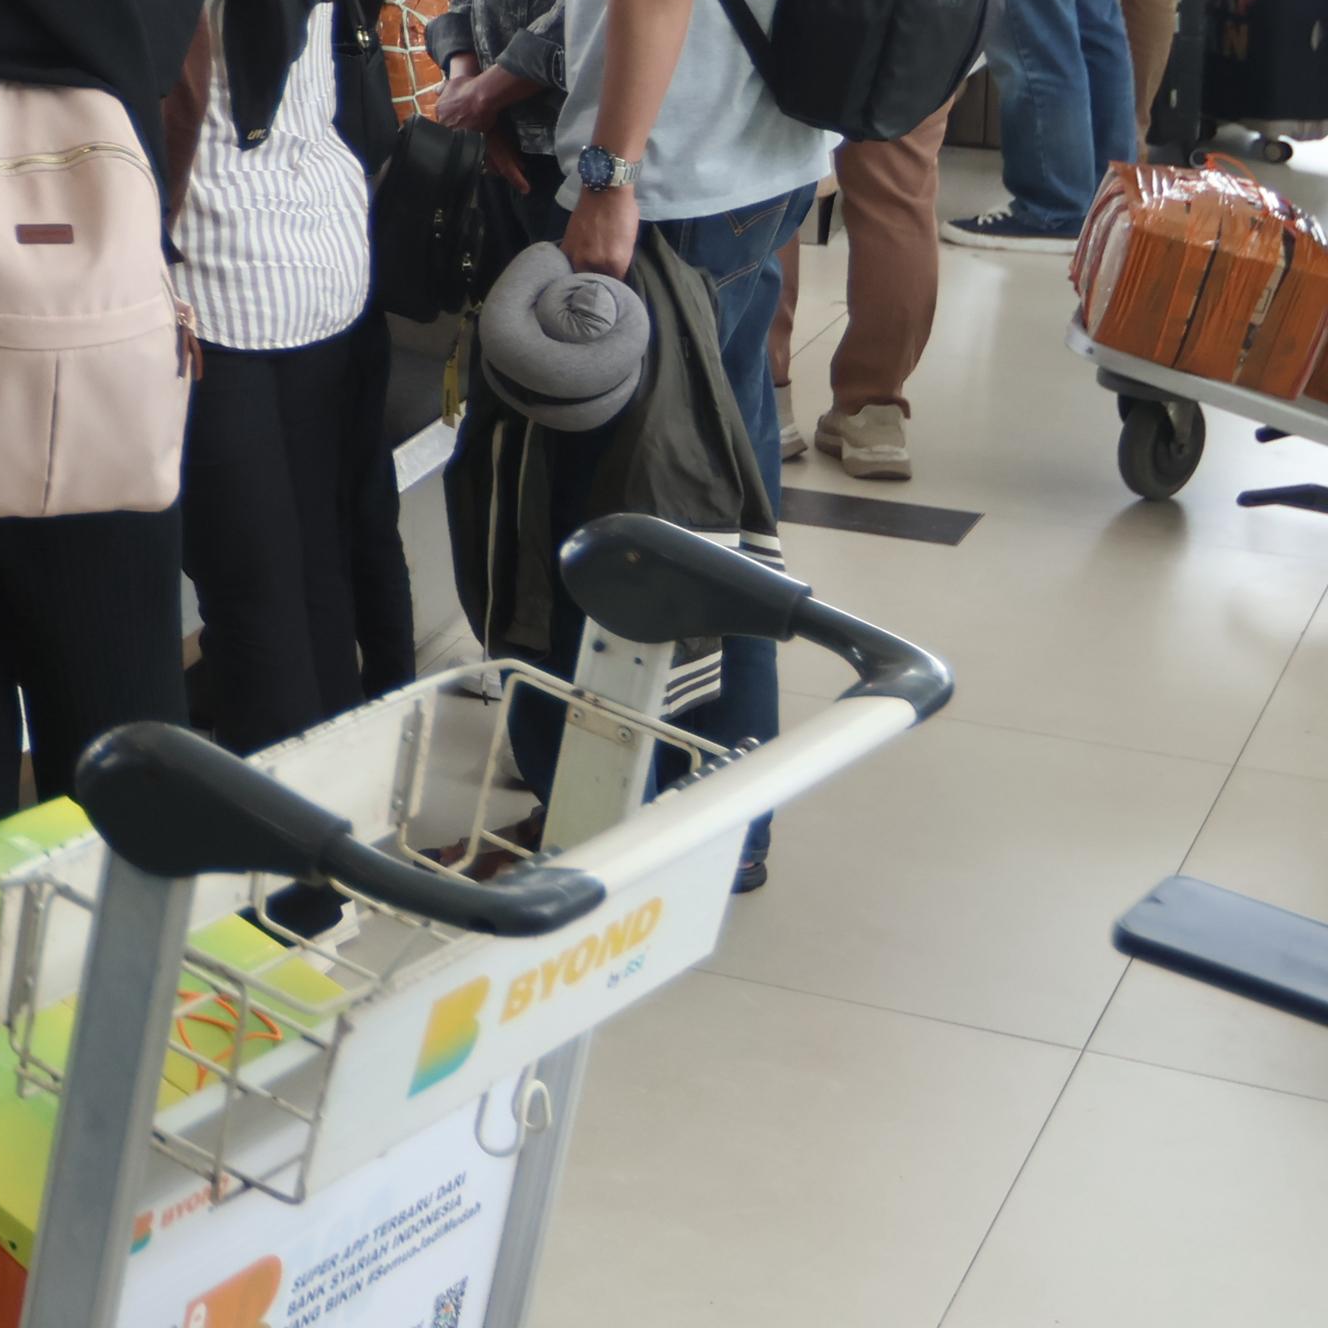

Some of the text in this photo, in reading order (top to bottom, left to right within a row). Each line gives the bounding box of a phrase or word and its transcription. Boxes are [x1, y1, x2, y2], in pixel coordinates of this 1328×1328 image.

[498, 896, 663, 1026] BYOND
[160, 1170, 232, 1230] BYO
[286, 1194, 463, 1318] BANK SYARIAH INDONESIA
[290, 1171, 468, 1293] SUPER APP TERBARU DARI
[323, 1278, 364, 1314] BIKIN
